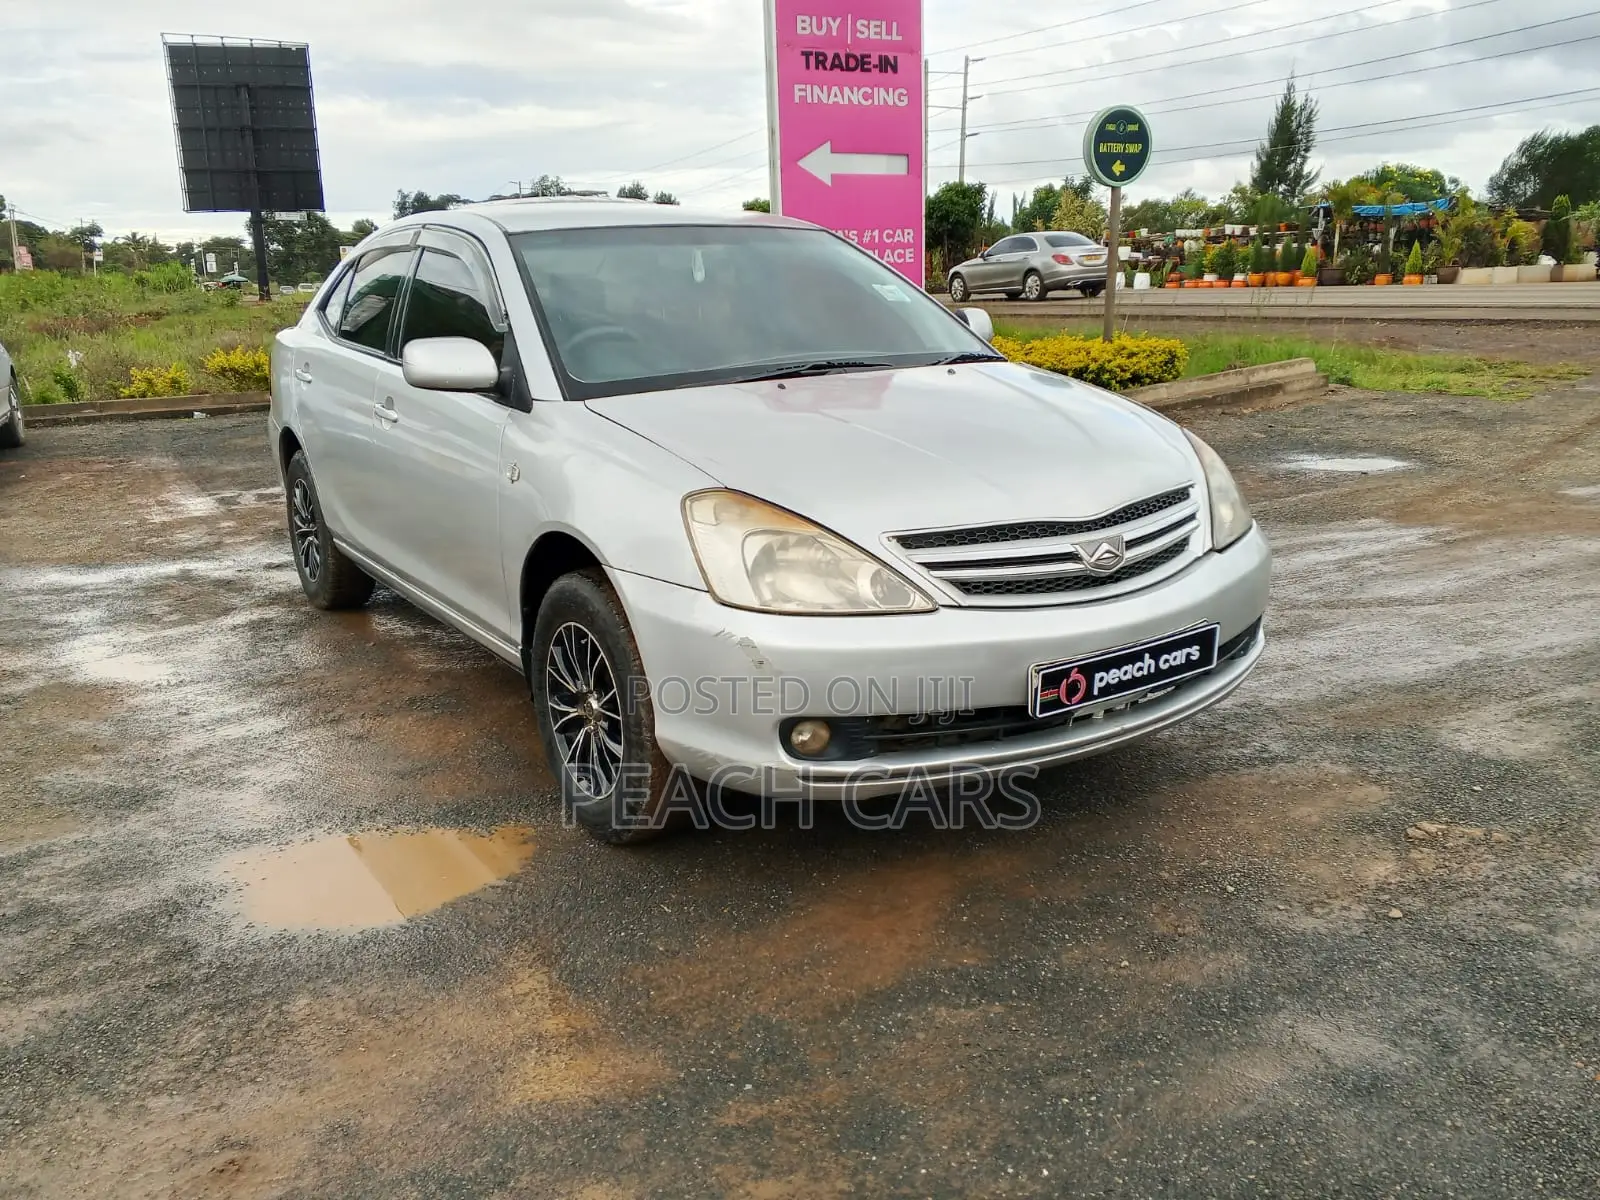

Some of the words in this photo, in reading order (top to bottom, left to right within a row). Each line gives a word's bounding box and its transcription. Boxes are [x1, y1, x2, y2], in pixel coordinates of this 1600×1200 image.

[796, 15, 842, 36] BUY
[856, 19, 903, 41] SELL
[801, 50, 899, 74] TRADE-IN
[794, 84, 909, 107] FINANCING
[1099, 142, 1125, 153] BATTERY
[1125, 143, 1142, 153] SWAP
[831, 229, 859, 243] A'S
[863, 229, 880, 244] #1
[883, 228, 914, 244] CAR
[1093, 652, 1155, 696] peach
[1158, 645, 1201, 671] cars
